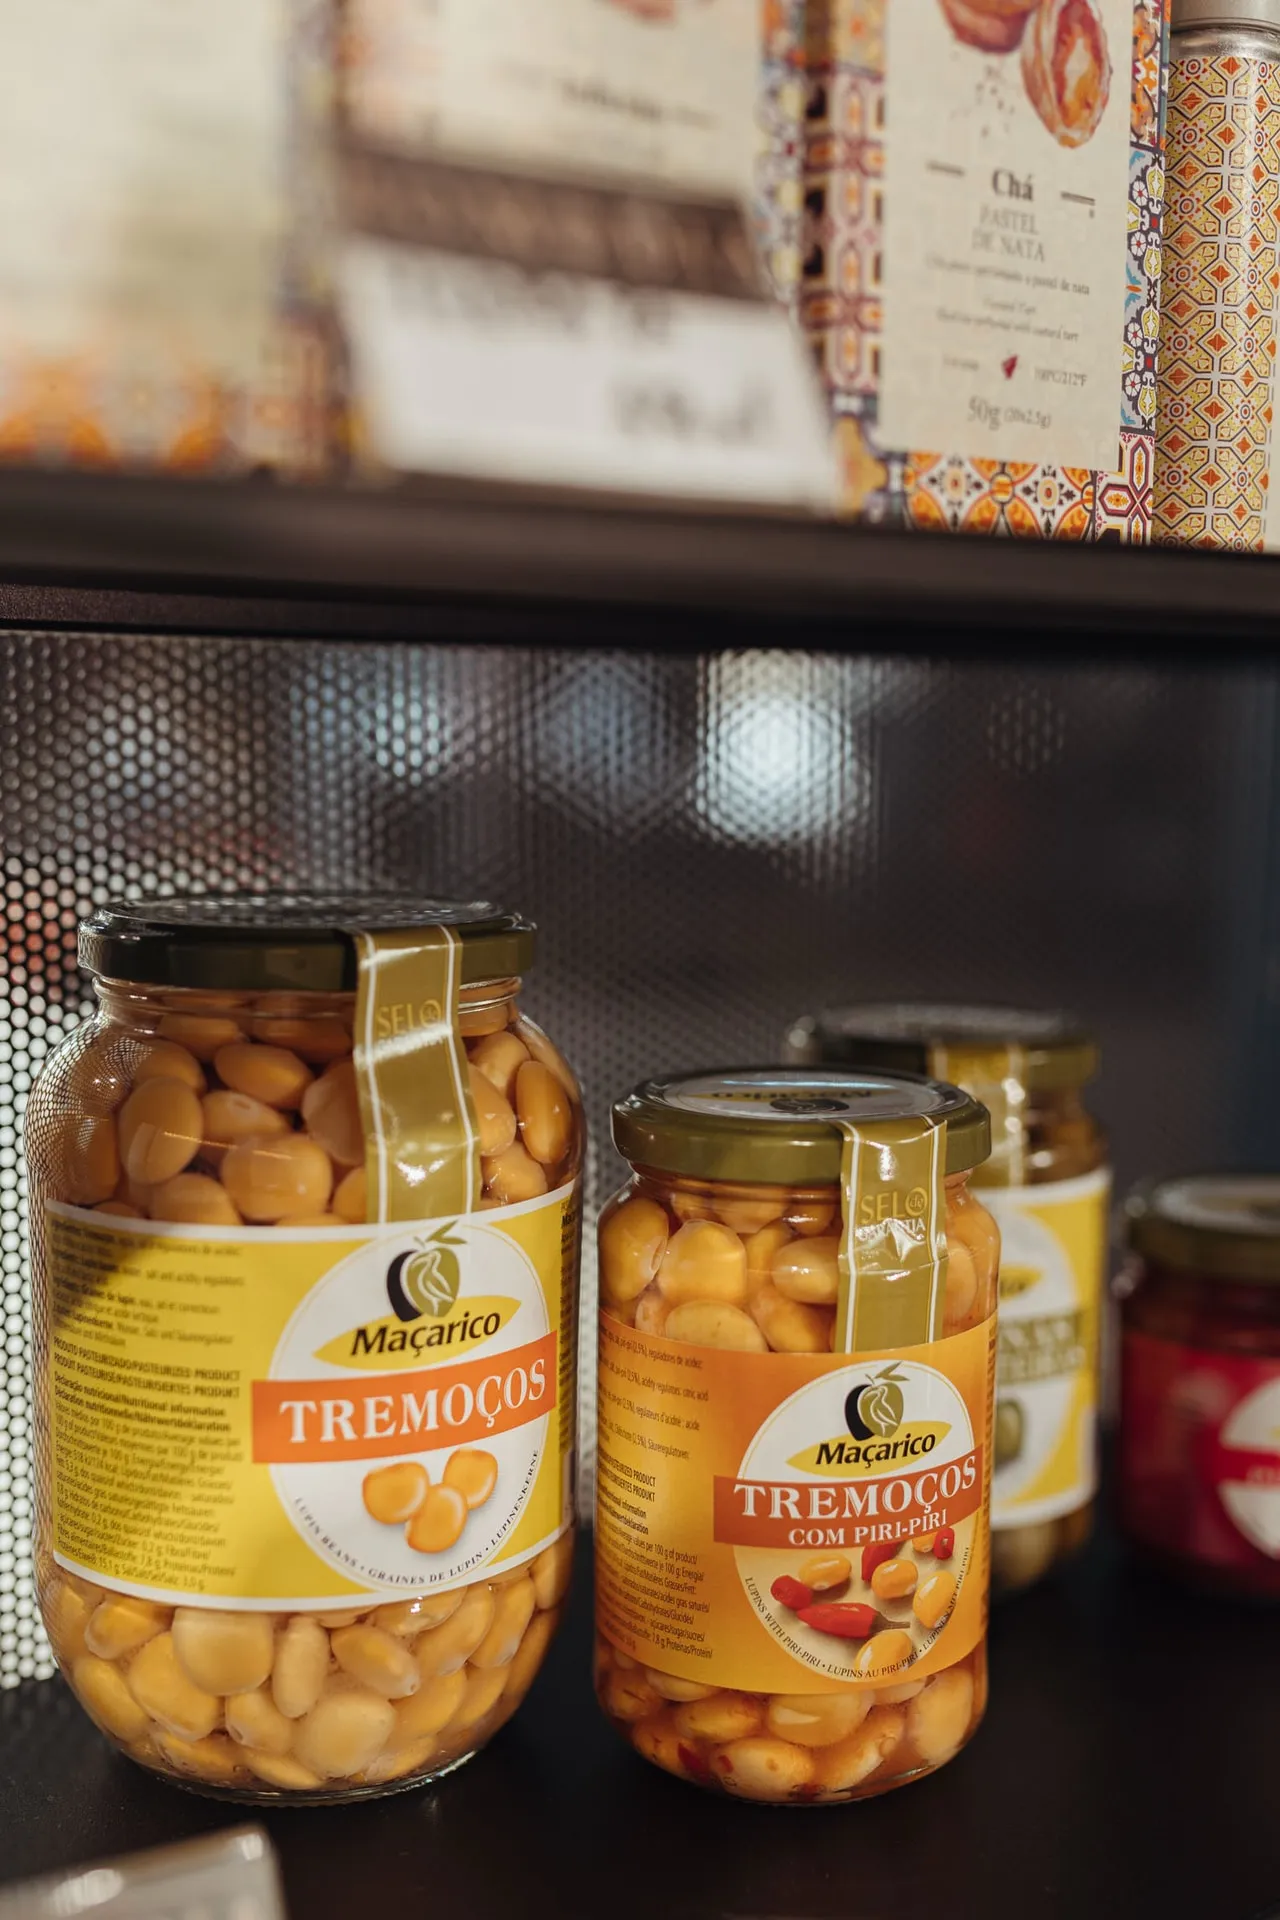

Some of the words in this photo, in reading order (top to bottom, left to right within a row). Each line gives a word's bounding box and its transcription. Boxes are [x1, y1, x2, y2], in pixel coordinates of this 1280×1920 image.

[992, 168, 1034, 202] Chá
[980, 205, 1039, 236] PASTEL
[1000, 236, 1045, 262] NATA
[377, 999, 442, 1038] SELO
[861, 1186, 928, 1224] SELO
[350, 1310, 501, 1357] Maçarico
[194, 1367, 240, 1380] PRODUCT
[280, 1358, 546, 1443] TREMOÇOS
[816, 1433, 936, 1469] Maçarico
[632, 1484, 655, 1503] PRODUKT
[633, 1467, 656, 1487] PRODUCT
[733, 1456, 976, 1519] TREMOÇOS
[321, 1535, 359, 1568] BEANS
[368, 1568, 425, 1586] GRAINES
[429, 1572, 446, 1583] DE
[450, 1552, 484, 1577] LUPIN
[490, 1450, 540, 1546] LUPINENKERNE
[788, 1527, 845, 1546] COM
[854, 1508, 948, 1545] PIRI-PIRI
[745, 1577, 767, 1613] LUPINS
[765, 1612, 785, 1638] WITH
[783, 1636, 822, 1668] PIRI-PIRI
[827, 1664, 863, 1679] LUPINS
[866, 1668, 880, 1679] AU
[882, 1651, 919, 1676] PIRI-PIRI
